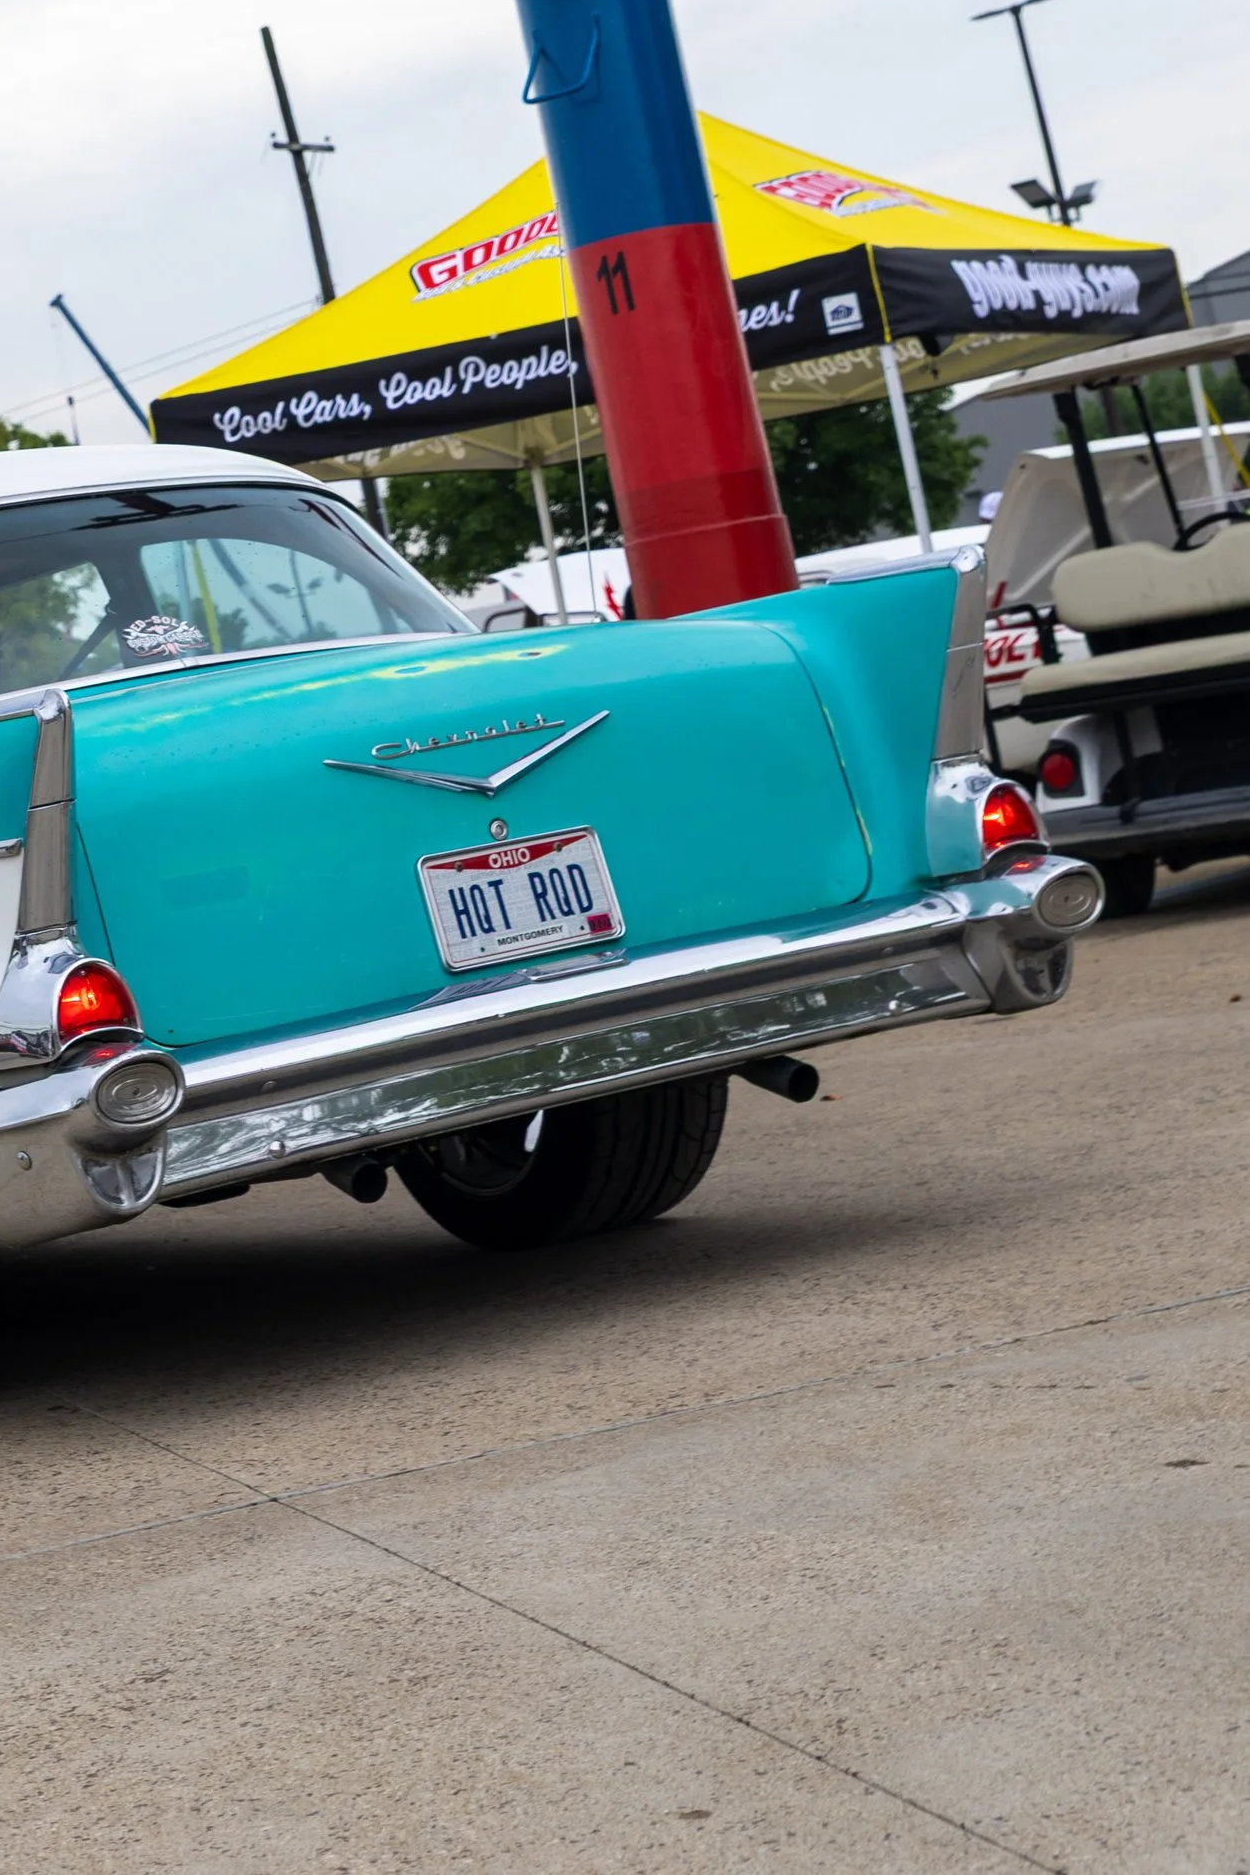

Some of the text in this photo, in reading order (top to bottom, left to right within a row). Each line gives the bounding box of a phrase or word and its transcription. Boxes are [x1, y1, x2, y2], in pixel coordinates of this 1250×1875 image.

[597, 251, 635, 316] 11
[213, 344, 579, 442] Cool Cars, Cool People,
[371, 713, 565, 760] Chevrolet
[488, 847, 531, 869] OHIO
[496, 924, 564, 947] MONTGOMERY
